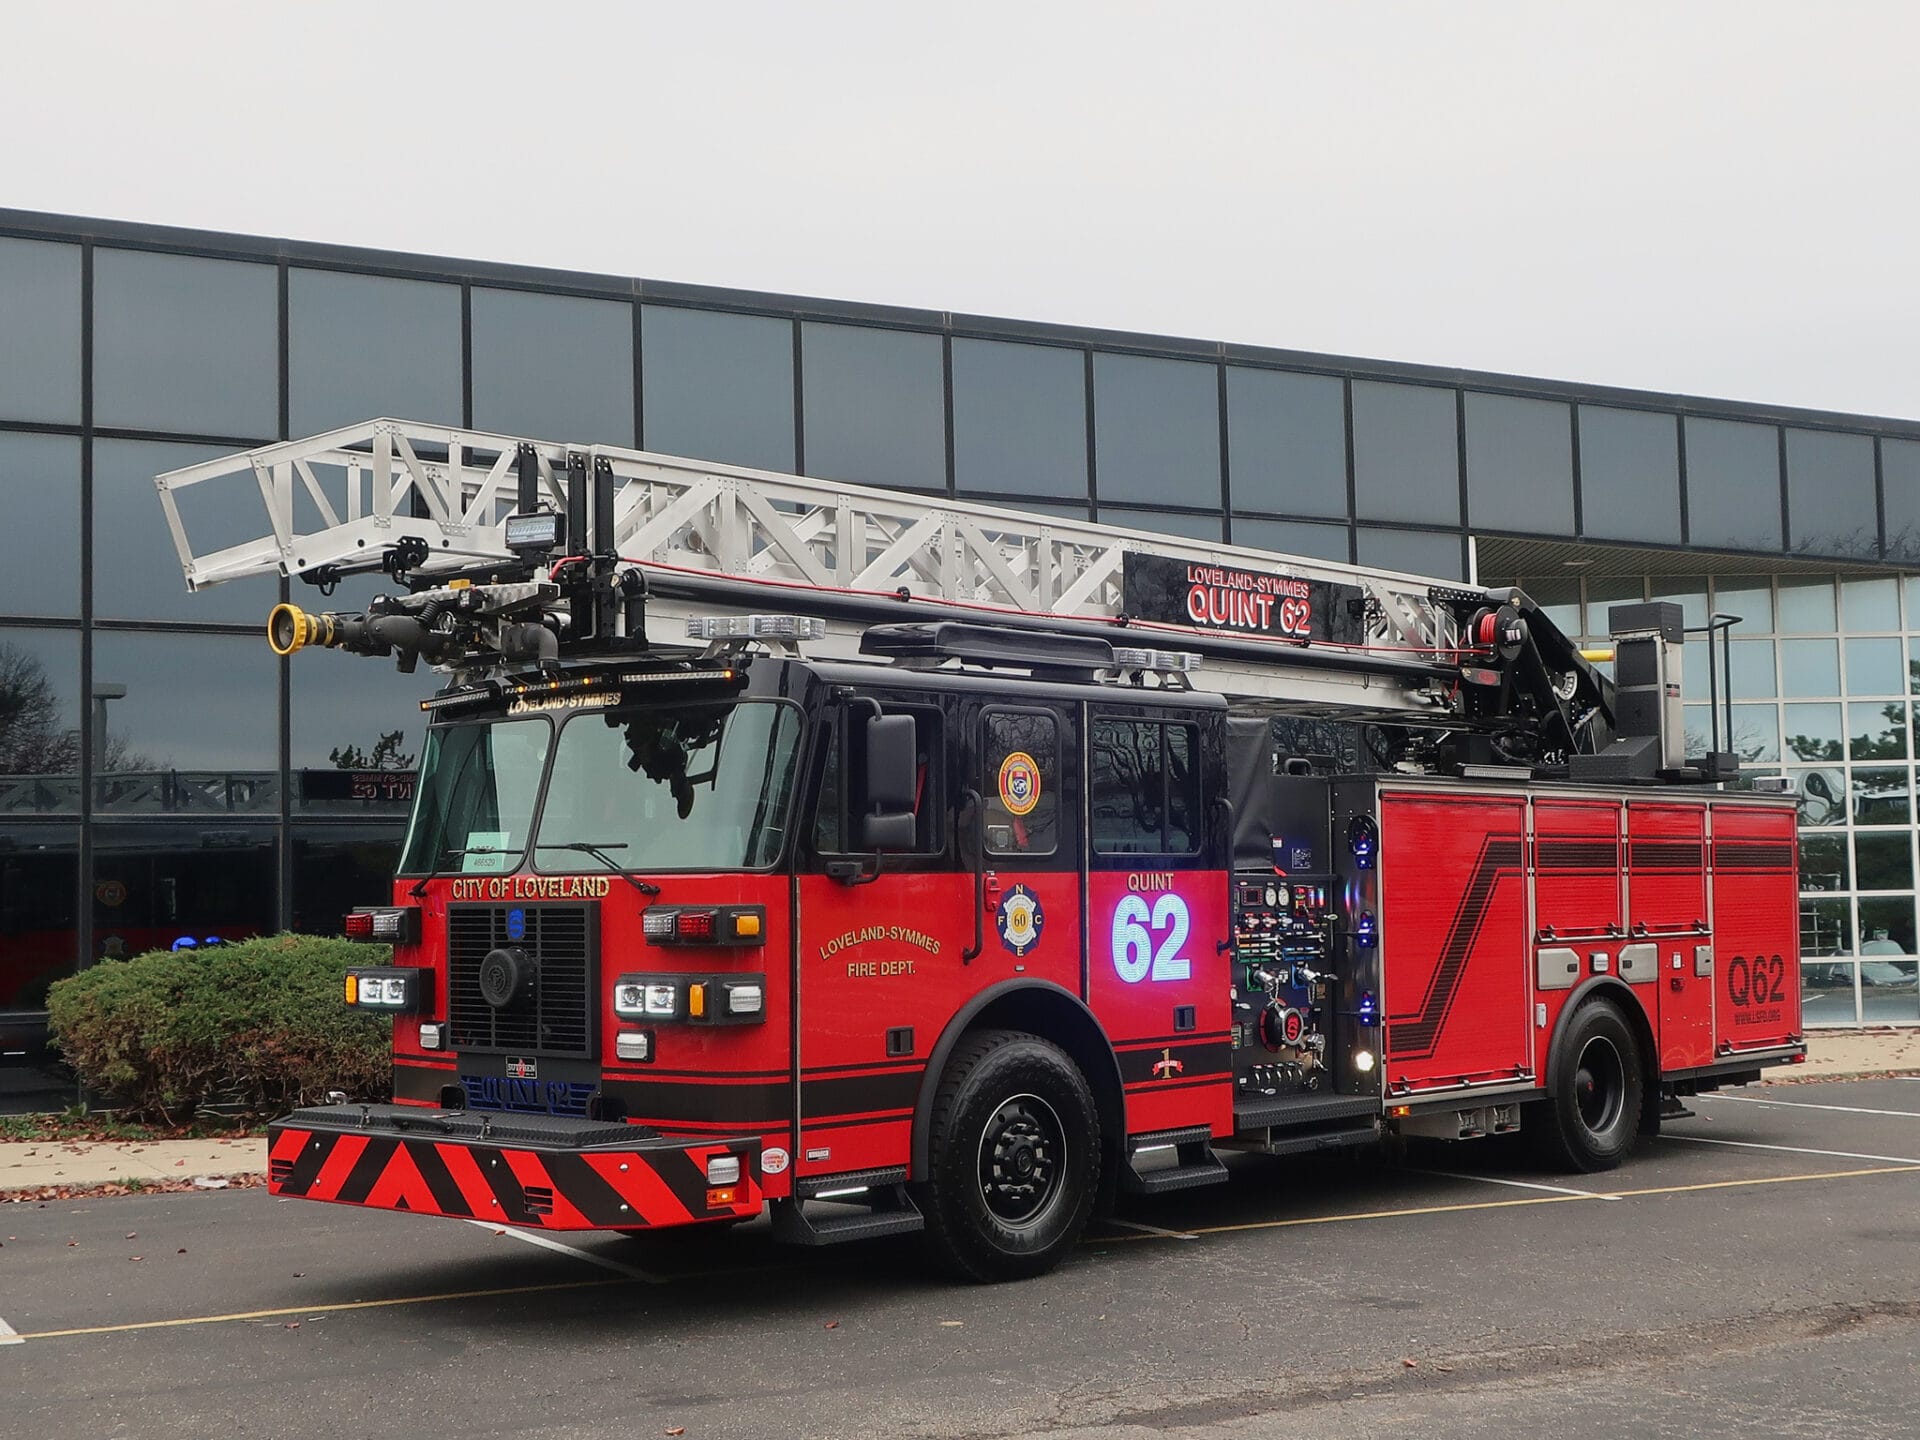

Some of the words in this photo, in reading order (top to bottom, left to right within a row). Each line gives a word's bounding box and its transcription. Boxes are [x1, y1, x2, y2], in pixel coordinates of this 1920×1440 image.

[1187, 565, 1312, 599] LOVELAND-SYMMES
[1187, 584, 1275, 630] QUINT
[1280, 597, 1312, 635] 62
[452, 878, 485, 899] CITY
[489, 878, 511, 898] OF
[514, 877, 610, 898] LOVELAND
[1015, 884, 1024, 894] N
[1127, 873, 1174, 892] QUINT
[997, 915, 1005, 926] F
[1013, 913, 1026, 927] 60
[1034, 914, 1042, 924] C
[820, 925, 941, 960] LOVELAND-SYMMES
[1112, 893, 1191, 983] 62
[1016, 946, 1024, 956] E
[847, 963, 877, 977] FIRE
[880, 960, 916, 975] DEPT.
[1728, 954, 1785, 1008] Q62
[482, 1077, 540, 1105] QUINT
[546, 1081, 569, 1108] 62
